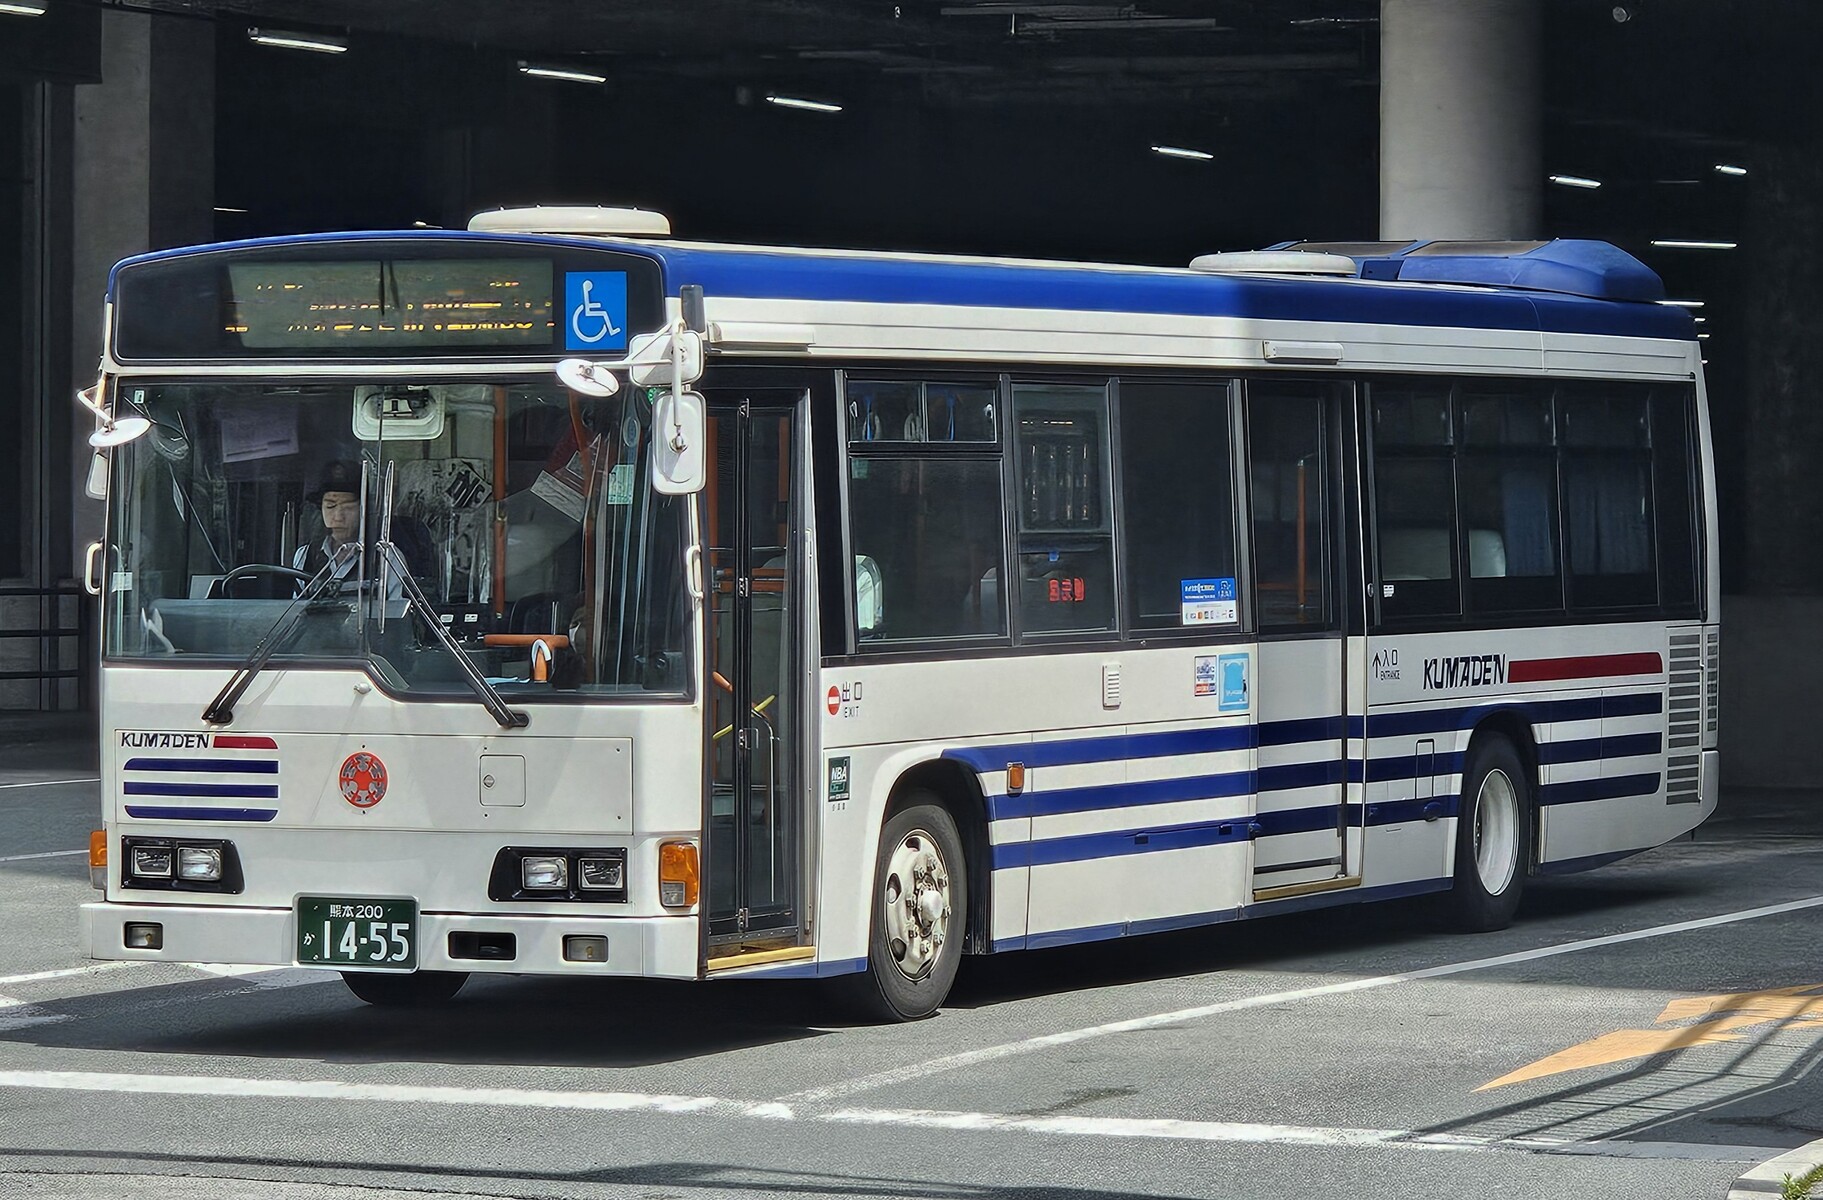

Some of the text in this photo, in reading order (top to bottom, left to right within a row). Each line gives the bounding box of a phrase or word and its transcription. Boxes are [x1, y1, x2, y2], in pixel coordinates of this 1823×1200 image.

[1382, 649, 1398, 666] 入口
[1380, 669, 1400, 680] ENTRANCE
[1423, 654, 1505, 690] KUMADEN
[842, 681, 863, 701] 出口
[844, 706, 860, 718] EXIT
[121, 732, 210, 749] KUMADEN
[831, 766, 847, 781] NBA
[303, 920, 410, 961] か 14-55
